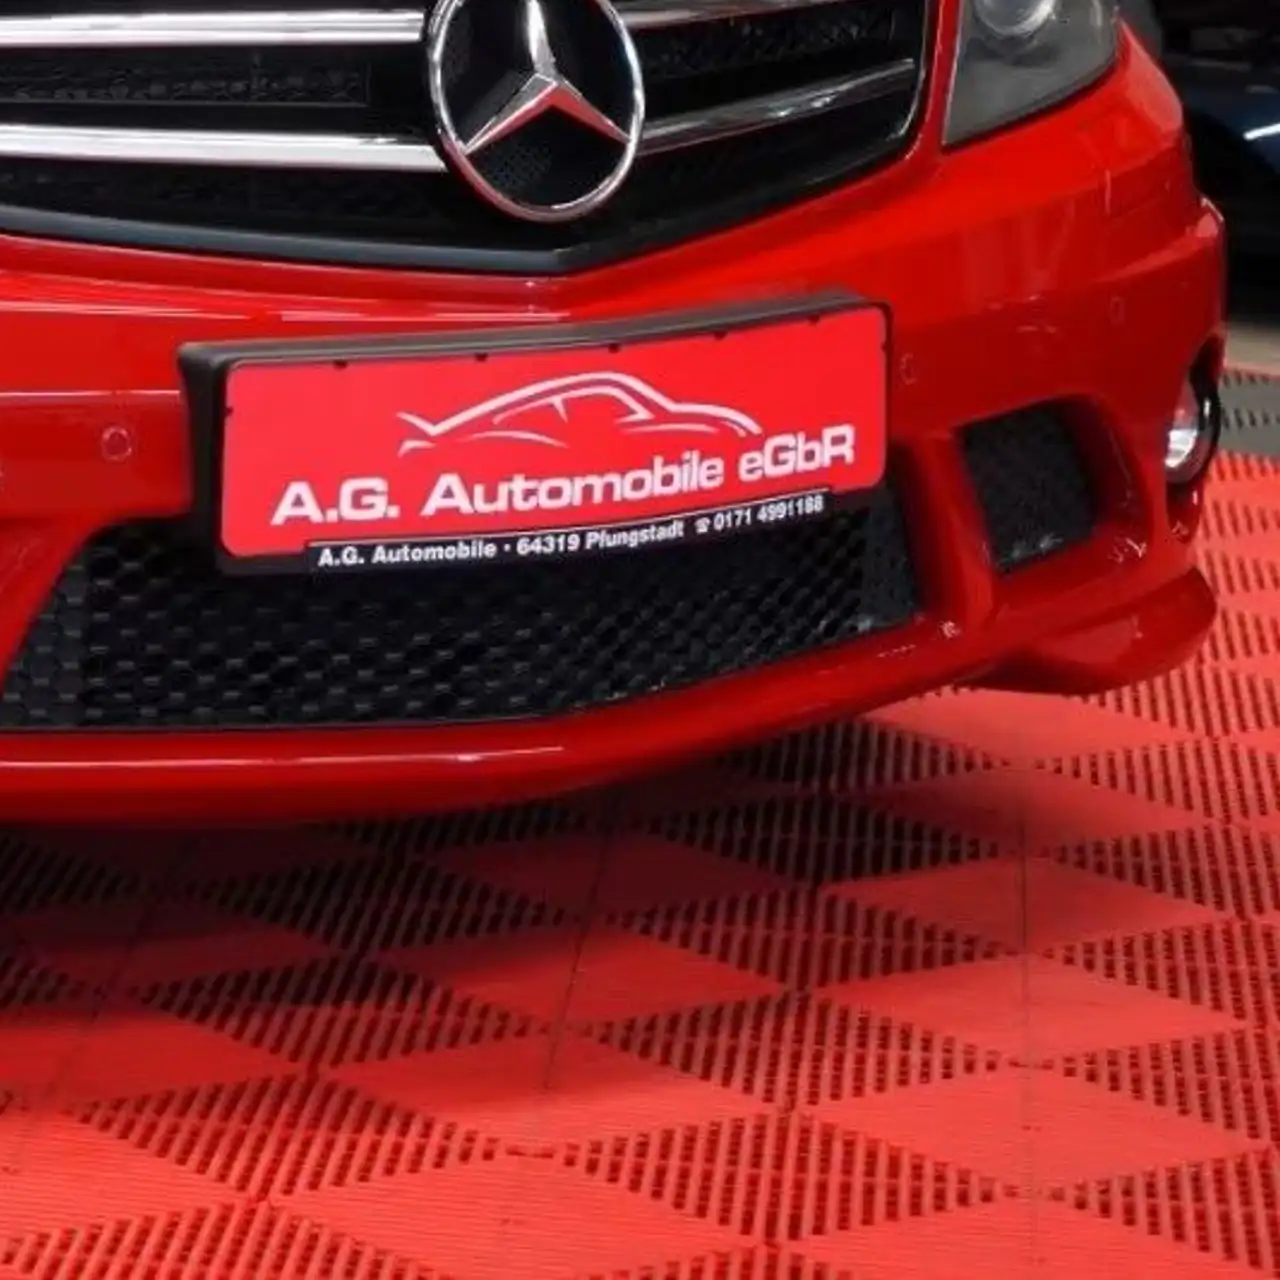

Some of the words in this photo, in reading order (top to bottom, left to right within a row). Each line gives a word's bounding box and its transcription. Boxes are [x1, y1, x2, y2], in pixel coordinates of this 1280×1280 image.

[270, 477, 401, 525] A.G.
[420, 449, 725, 516] Automobile
[738, 424, 856, 483] eGbR
[318, 545, 365, 567] A.G.
[372, 540, 497, 564] Automobile
[515, 535, 580, 556] 64319
[585, 523, 685, 552] Pfungstadt
[712, 508, 752, 531] 0171
